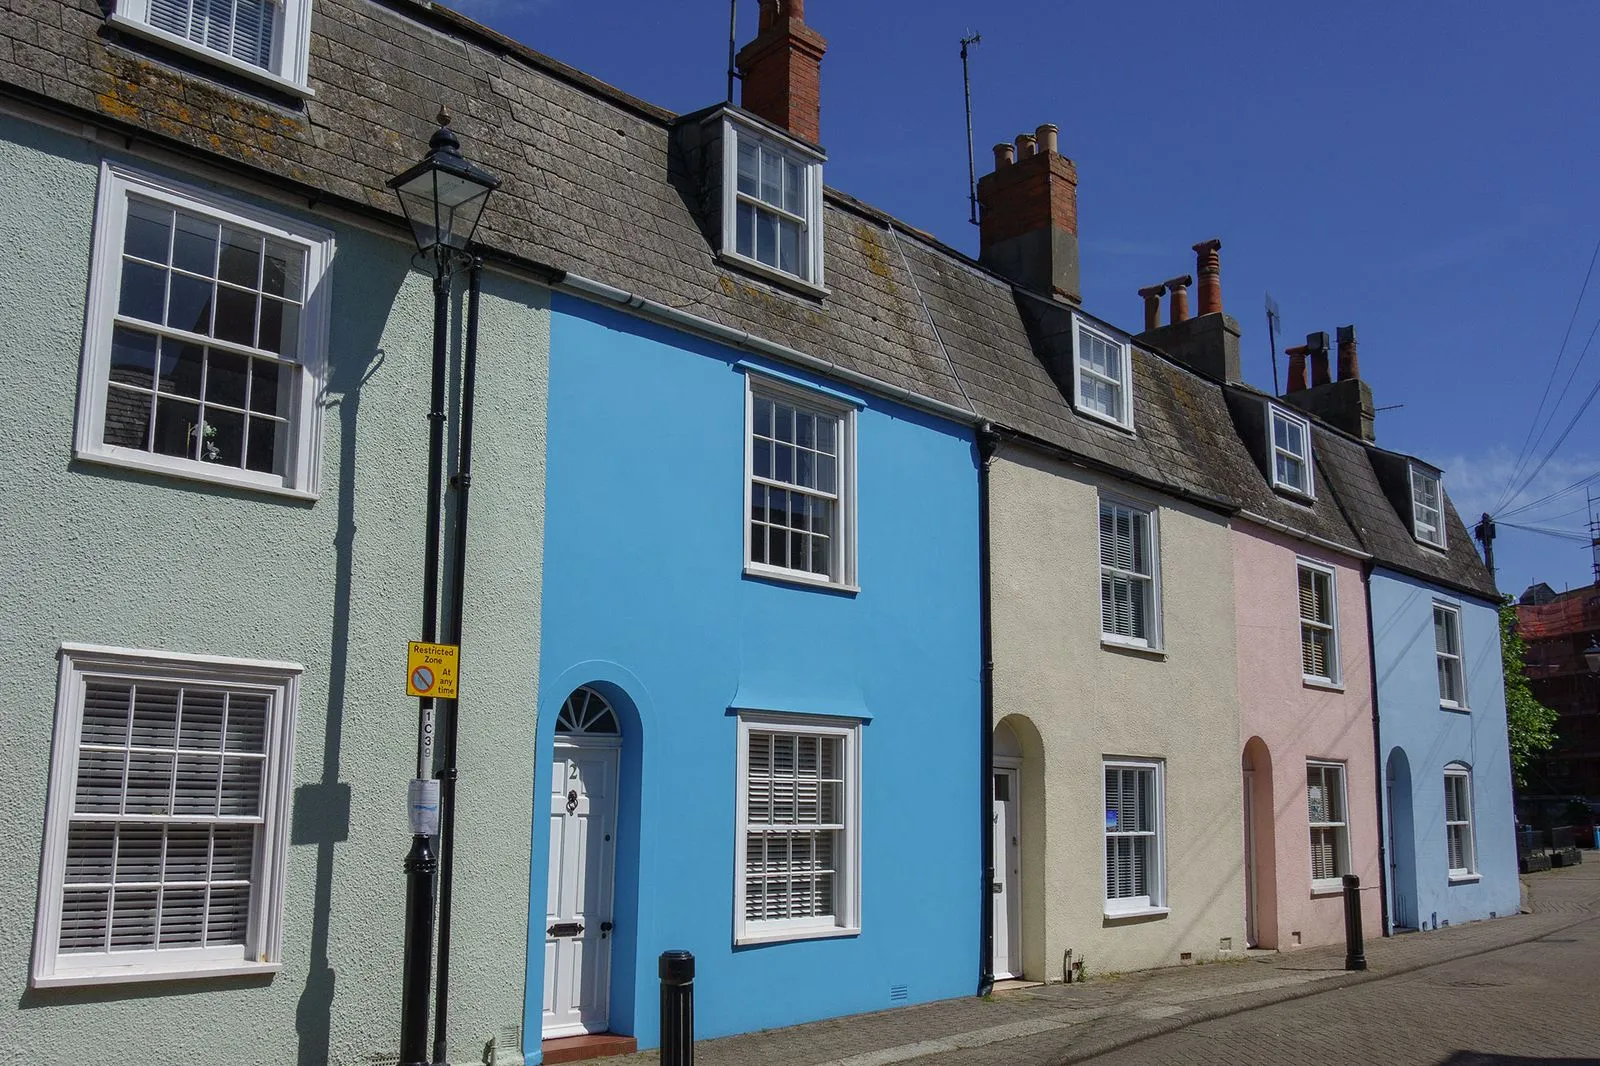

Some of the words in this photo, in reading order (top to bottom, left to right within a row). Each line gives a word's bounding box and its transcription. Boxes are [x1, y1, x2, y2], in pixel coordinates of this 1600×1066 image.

[413, 645, 454, 656] Restricted
[424, 656, 443, 664] Zone
[442, 668, 451, 676] At
[438, 686, 455, 695] time
[569, 763, 578, 780] 2
